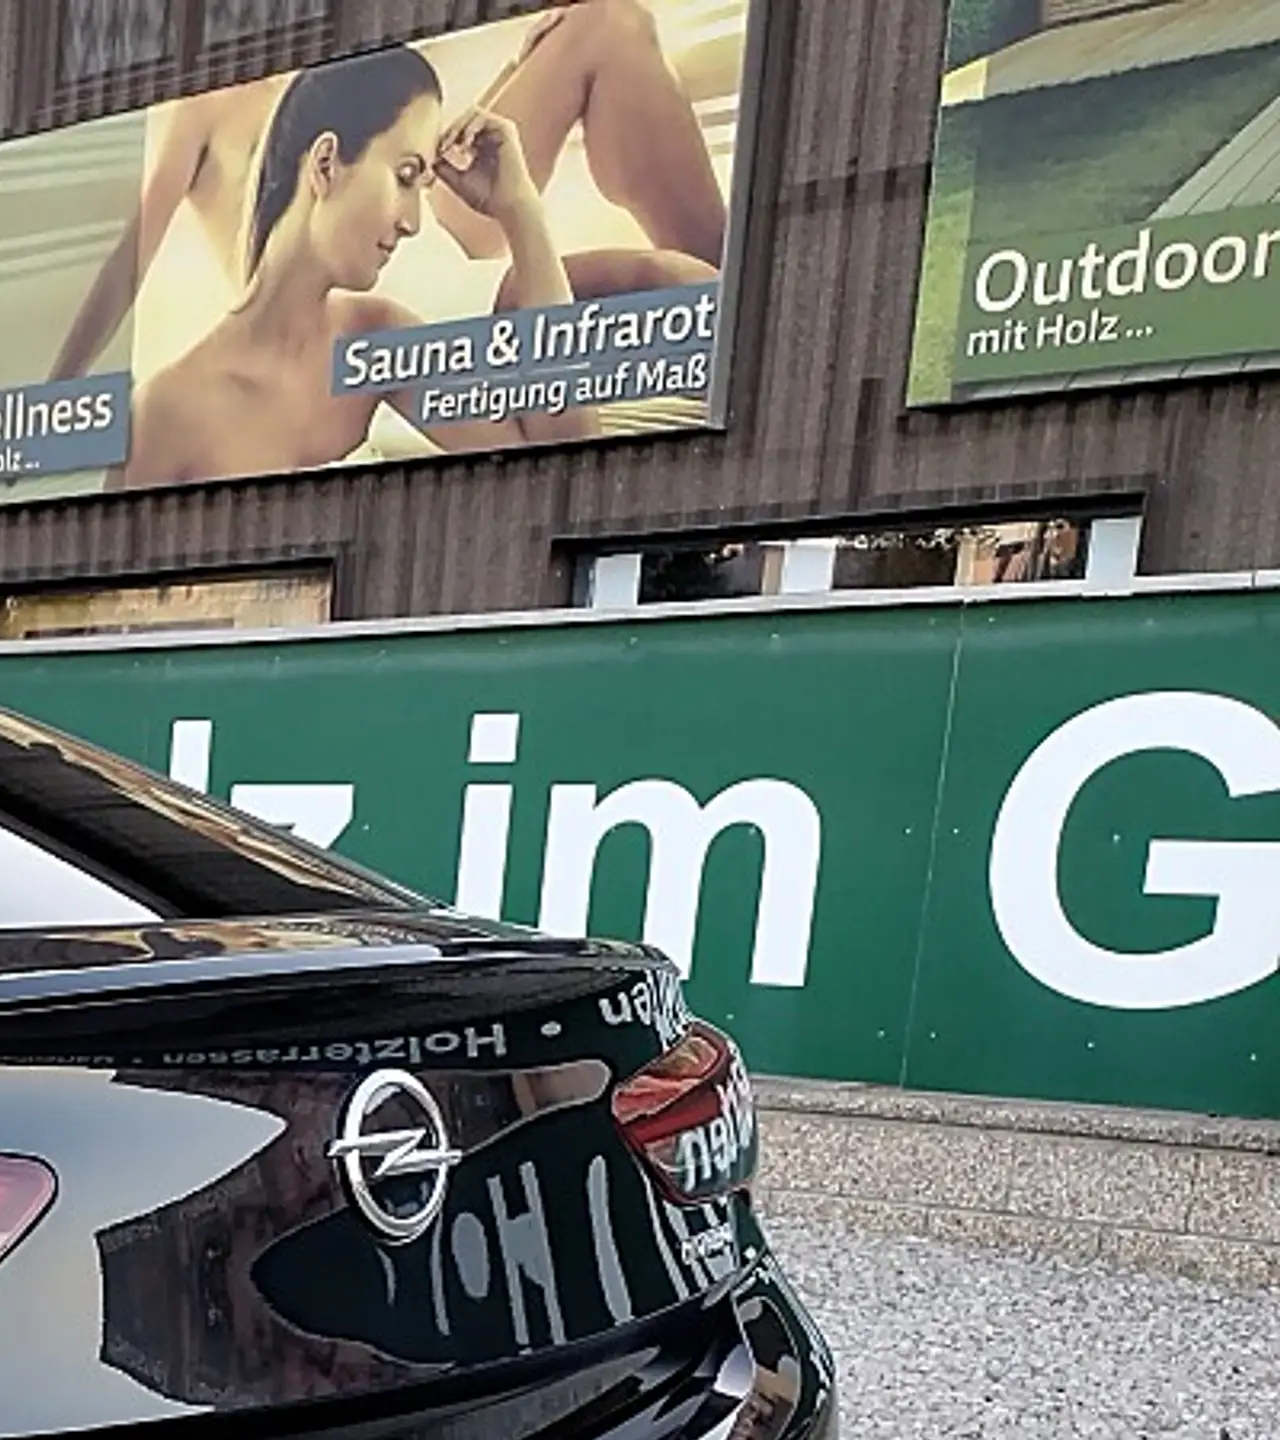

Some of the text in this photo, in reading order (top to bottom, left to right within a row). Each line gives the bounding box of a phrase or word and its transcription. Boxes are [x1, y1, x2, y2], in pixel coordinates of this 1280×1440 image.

[975, 227, 1280, 312] Outdoor
[343, 293, 714, 386] Sauna & Infrarot
[966, 319, 1028, 356] mit
[422, 353, 707, 423] Fertigung auf Maß
[453, 713, 824, 989] im
